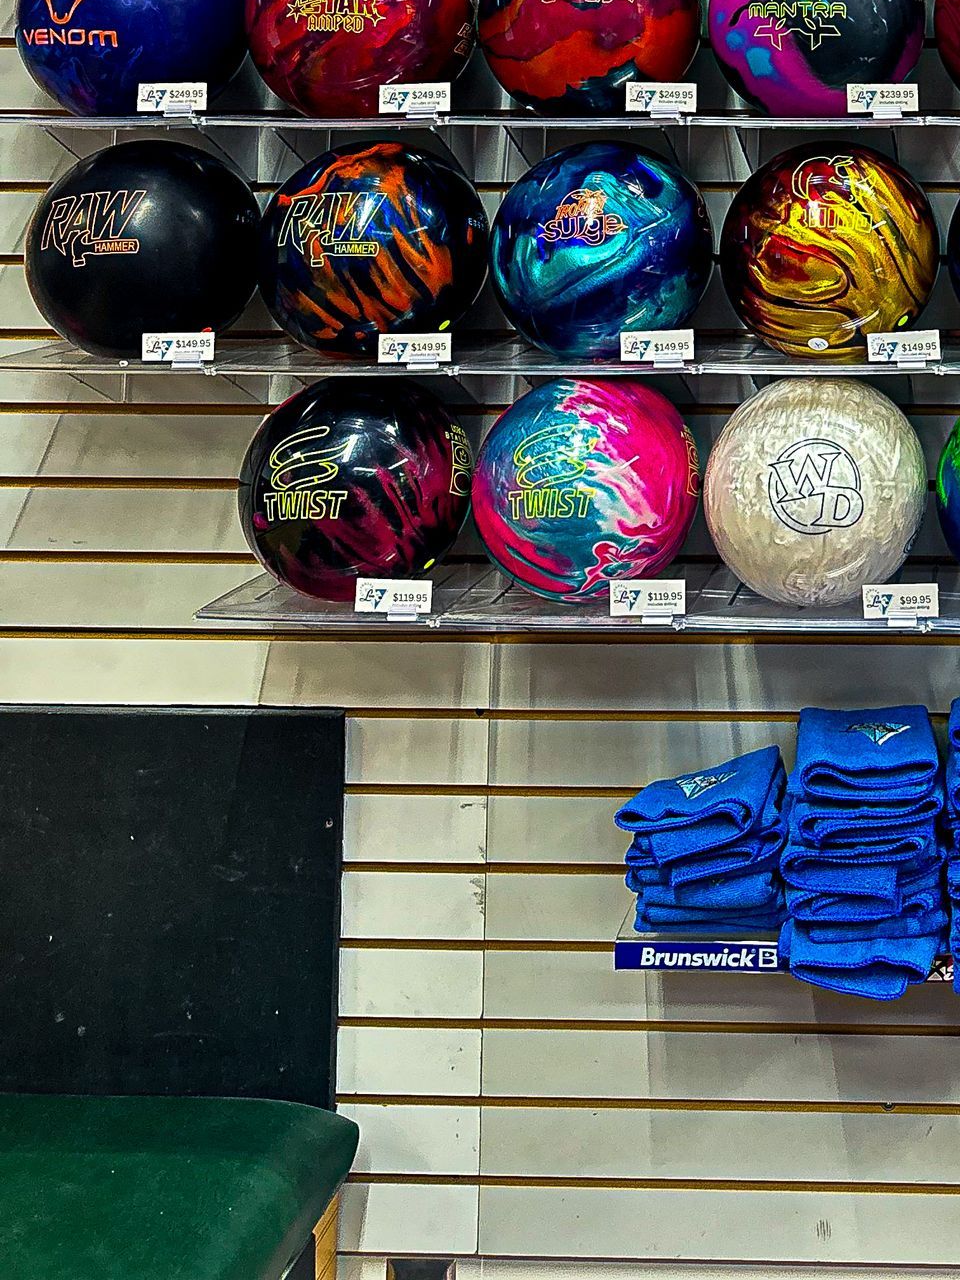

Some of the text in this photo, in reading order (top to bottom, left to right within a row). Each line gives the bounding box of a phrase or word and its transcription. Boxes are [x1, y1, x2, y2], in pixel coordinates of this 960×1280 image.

[748, 2, 846, 20] MANTRA
[170, 90, 203, 99] $249.95
[412, 91, 446, 99] $249.95
[41, 190, 146, 251] RAW
[278, 192, 386, 251] RAW
[95, 241, 136, 253] HAMMER
[335, 242, 375, 255] HAMMER
[176, 340, 210, 348] $149.95
[411, 343, 446, 351] $149.95
[655, 342, 689, 351] $149.95
[902, 342, 937, 352] $149.95
[264, 490, 347, 521] TWIST
[508, 489, 595, 520] TWIST
[393, 593, 427, 602] $119.95
[648, 592, 682, 601] $119.95
[900, 596, 931, 605] $99.95
[641, 947, 754, 968] Brunswick
